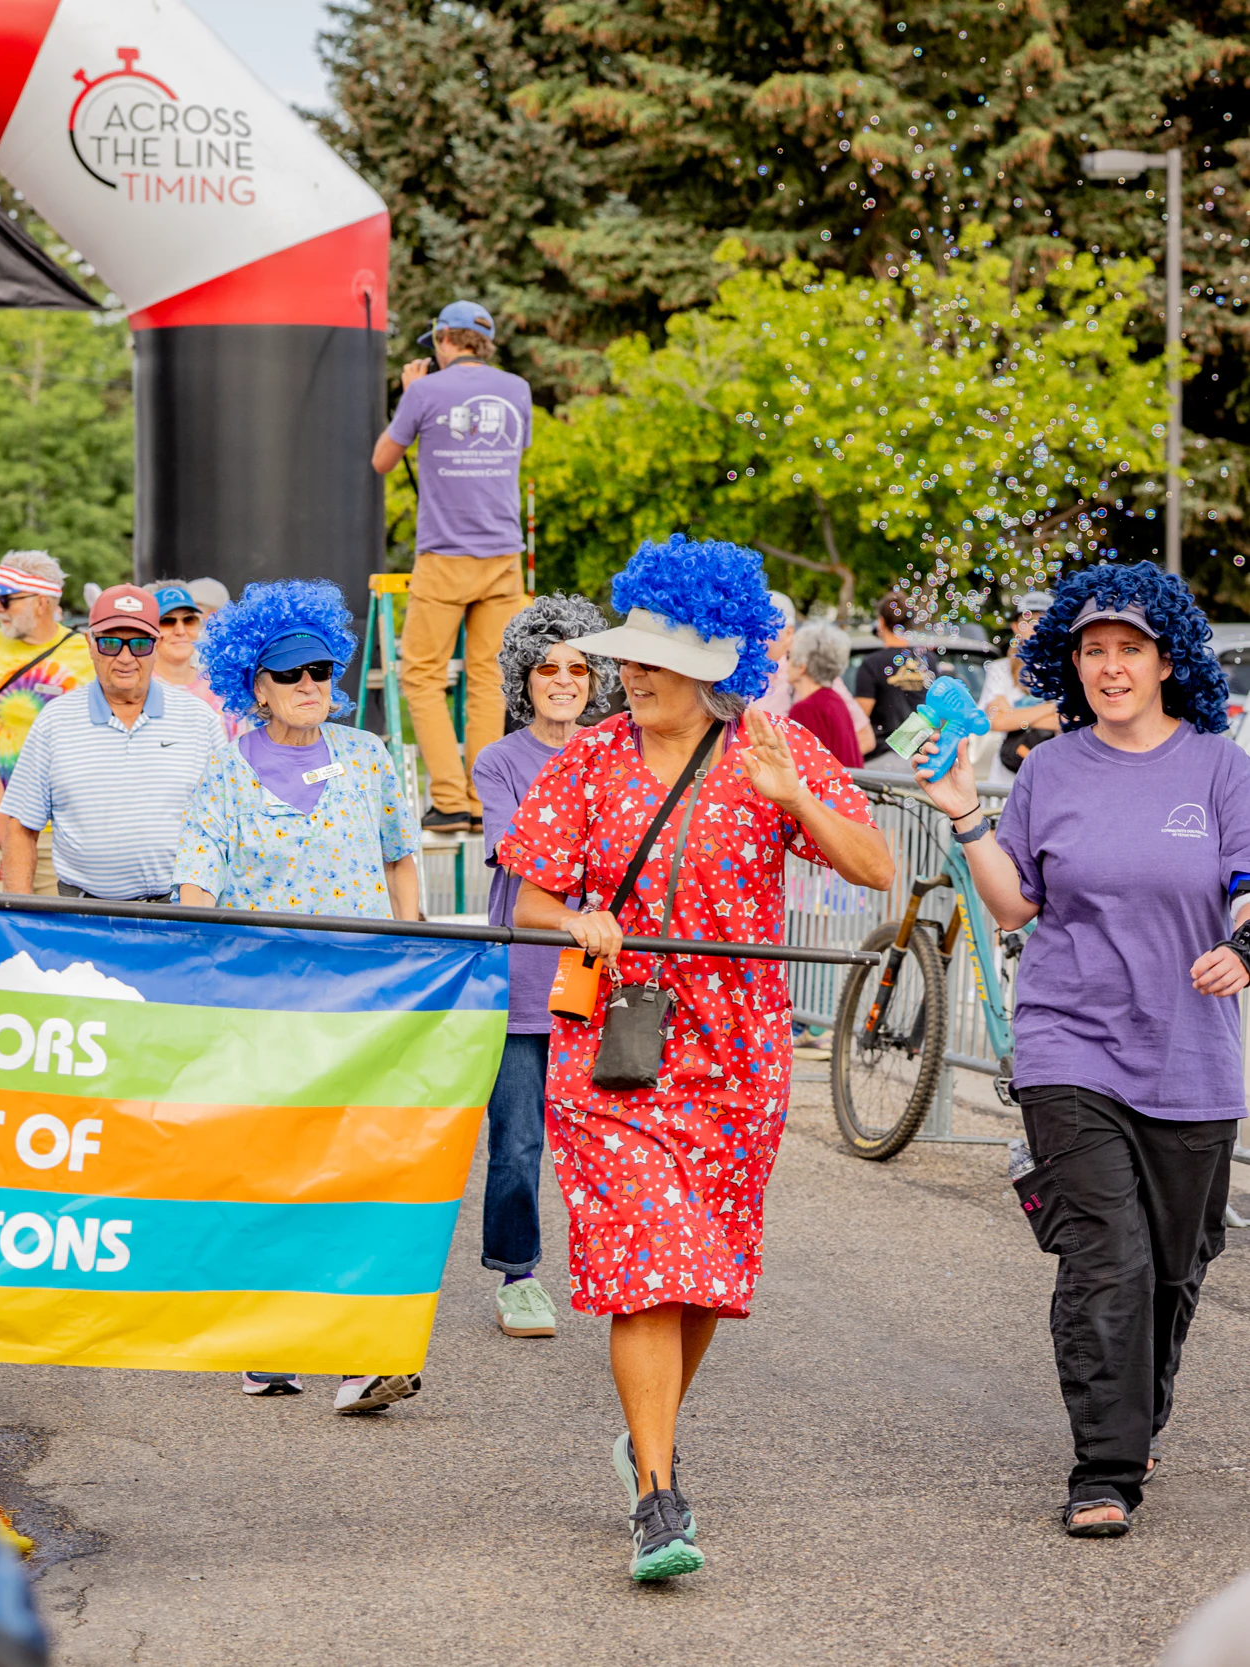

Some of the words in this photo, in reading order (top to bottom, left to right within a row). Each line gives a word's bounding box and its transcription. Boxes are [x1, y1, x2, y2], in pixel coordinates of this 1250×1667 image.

[103, 102, 252, 138] ACROSS
[89, 135, 160, 167] THE
[174, 138, 255, 171] LINE
[121, 172, 256, 206] TIMING
[956, 893, 976, 953] SANTA
[15, 1113, 103, 1172] OF
